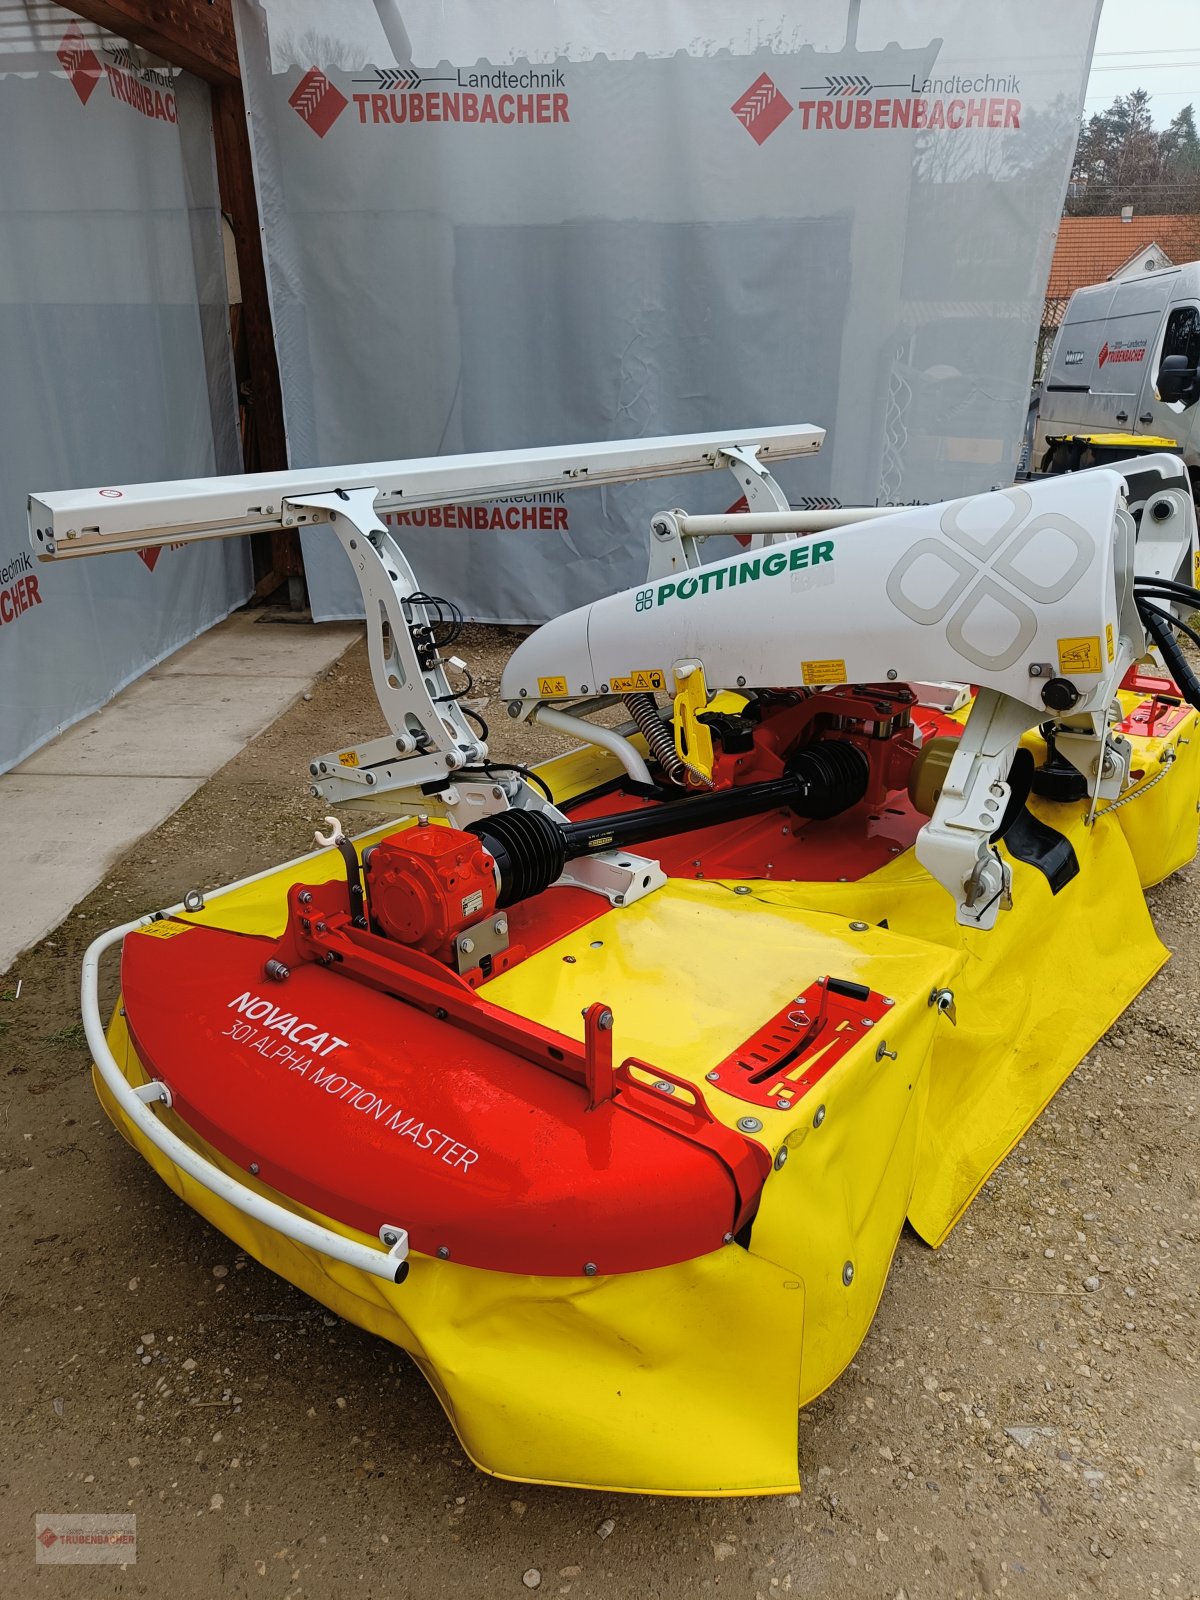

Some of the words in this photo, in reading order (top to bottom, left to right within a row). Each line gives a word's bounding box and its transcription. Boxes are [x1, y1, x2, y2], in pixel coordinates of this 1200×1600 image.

[457, 69, 566, 89] Landtechnik
[911, 74, 1021, 94] Landtechnik
[352, 92, 570, 124] TRUBENBACHER
[798, 98, 1022, 130] TRUBENBACHER
[0, 574, 42, 626] CHER
[227, 991, 349, 1057] NOVACAT
[221, 1019, 258, 1044] 301
[249, 1034, 313, 1077] ALPHA
[308, 1066, 392, 1121] MOTION
[384, 1109, 480, 1174] MASTER
